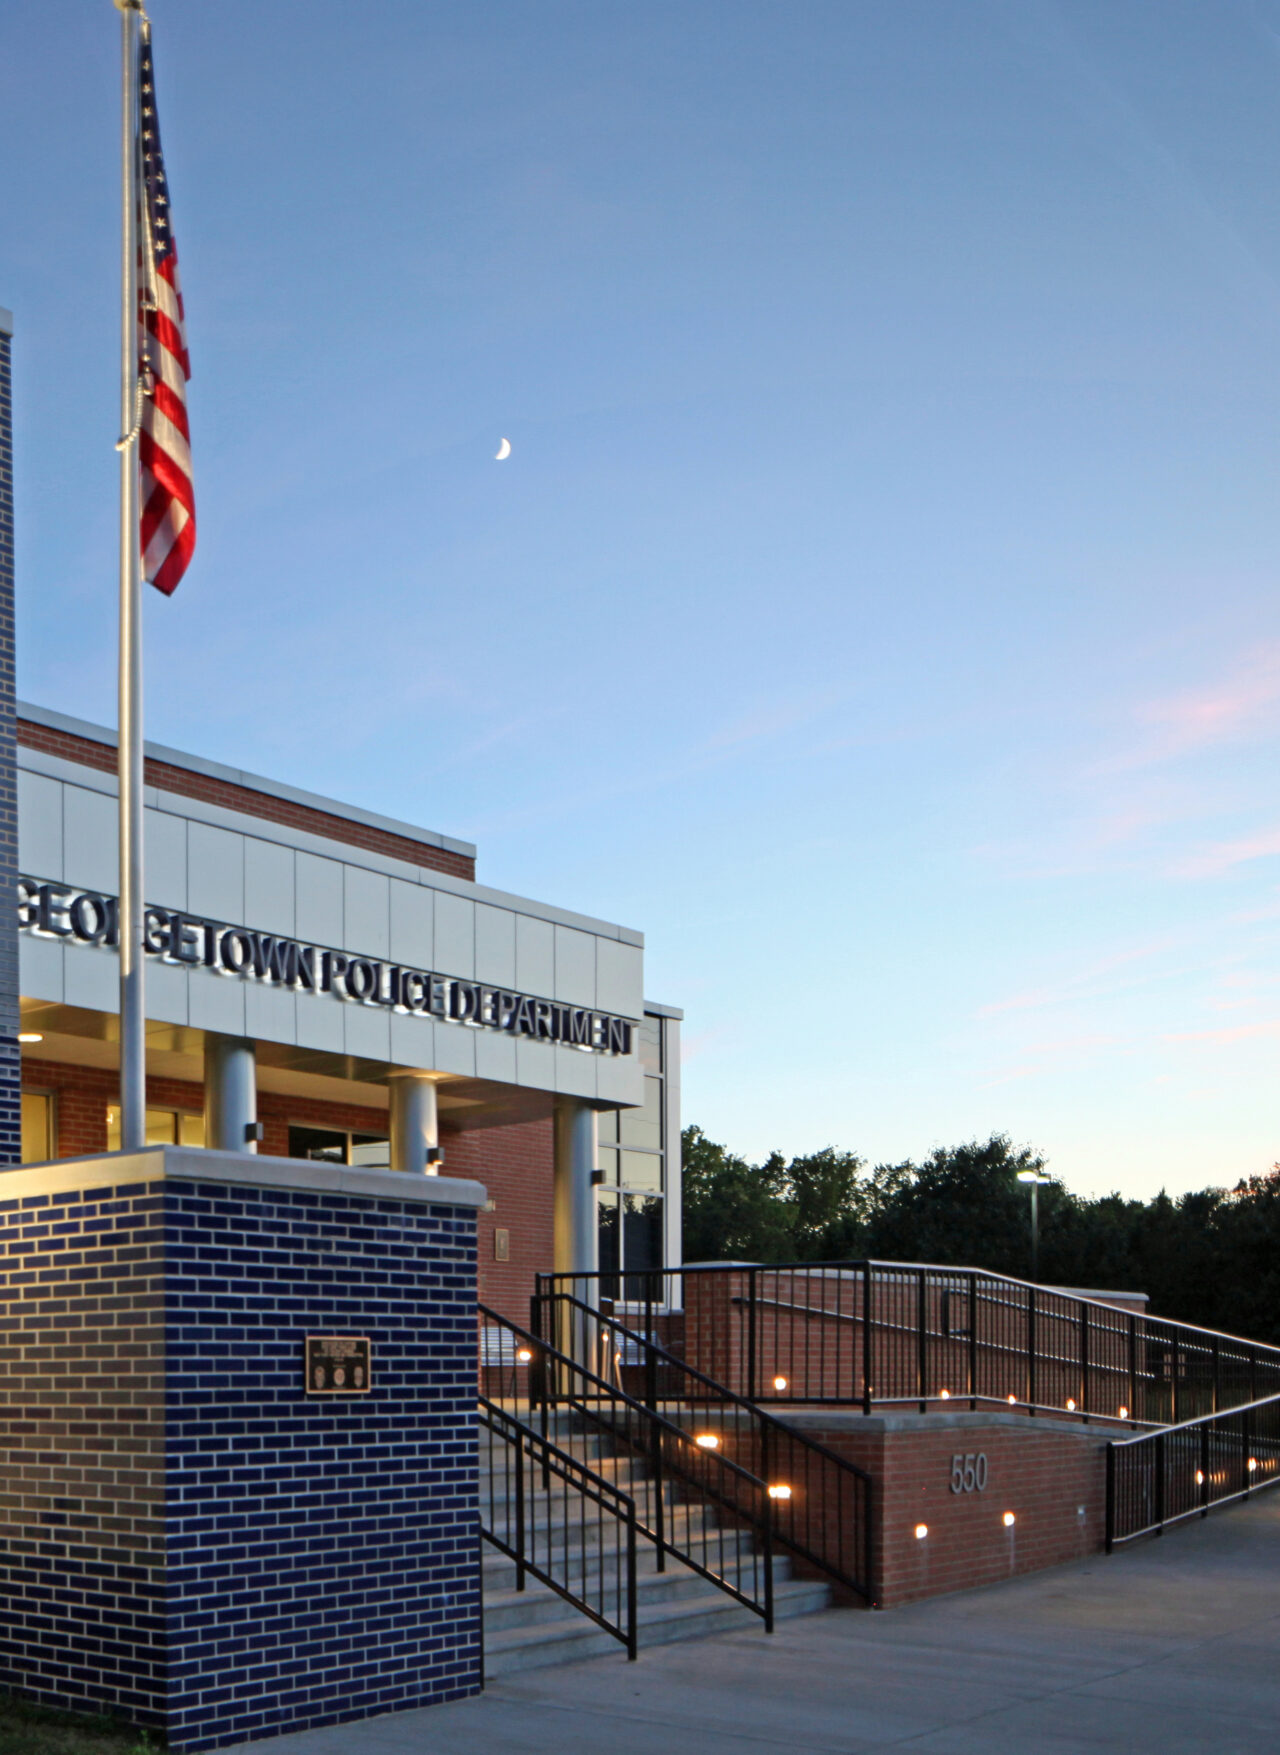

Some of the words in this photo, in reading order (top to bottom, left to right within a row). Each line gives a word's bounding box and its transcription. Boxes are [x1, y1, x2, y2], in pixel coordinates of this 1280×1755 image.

[321, 951, 447, 1016] POLICE
[451, 981, 638, 1055] DEPARTMENT
[950, 1452, 988, 1495] 550
